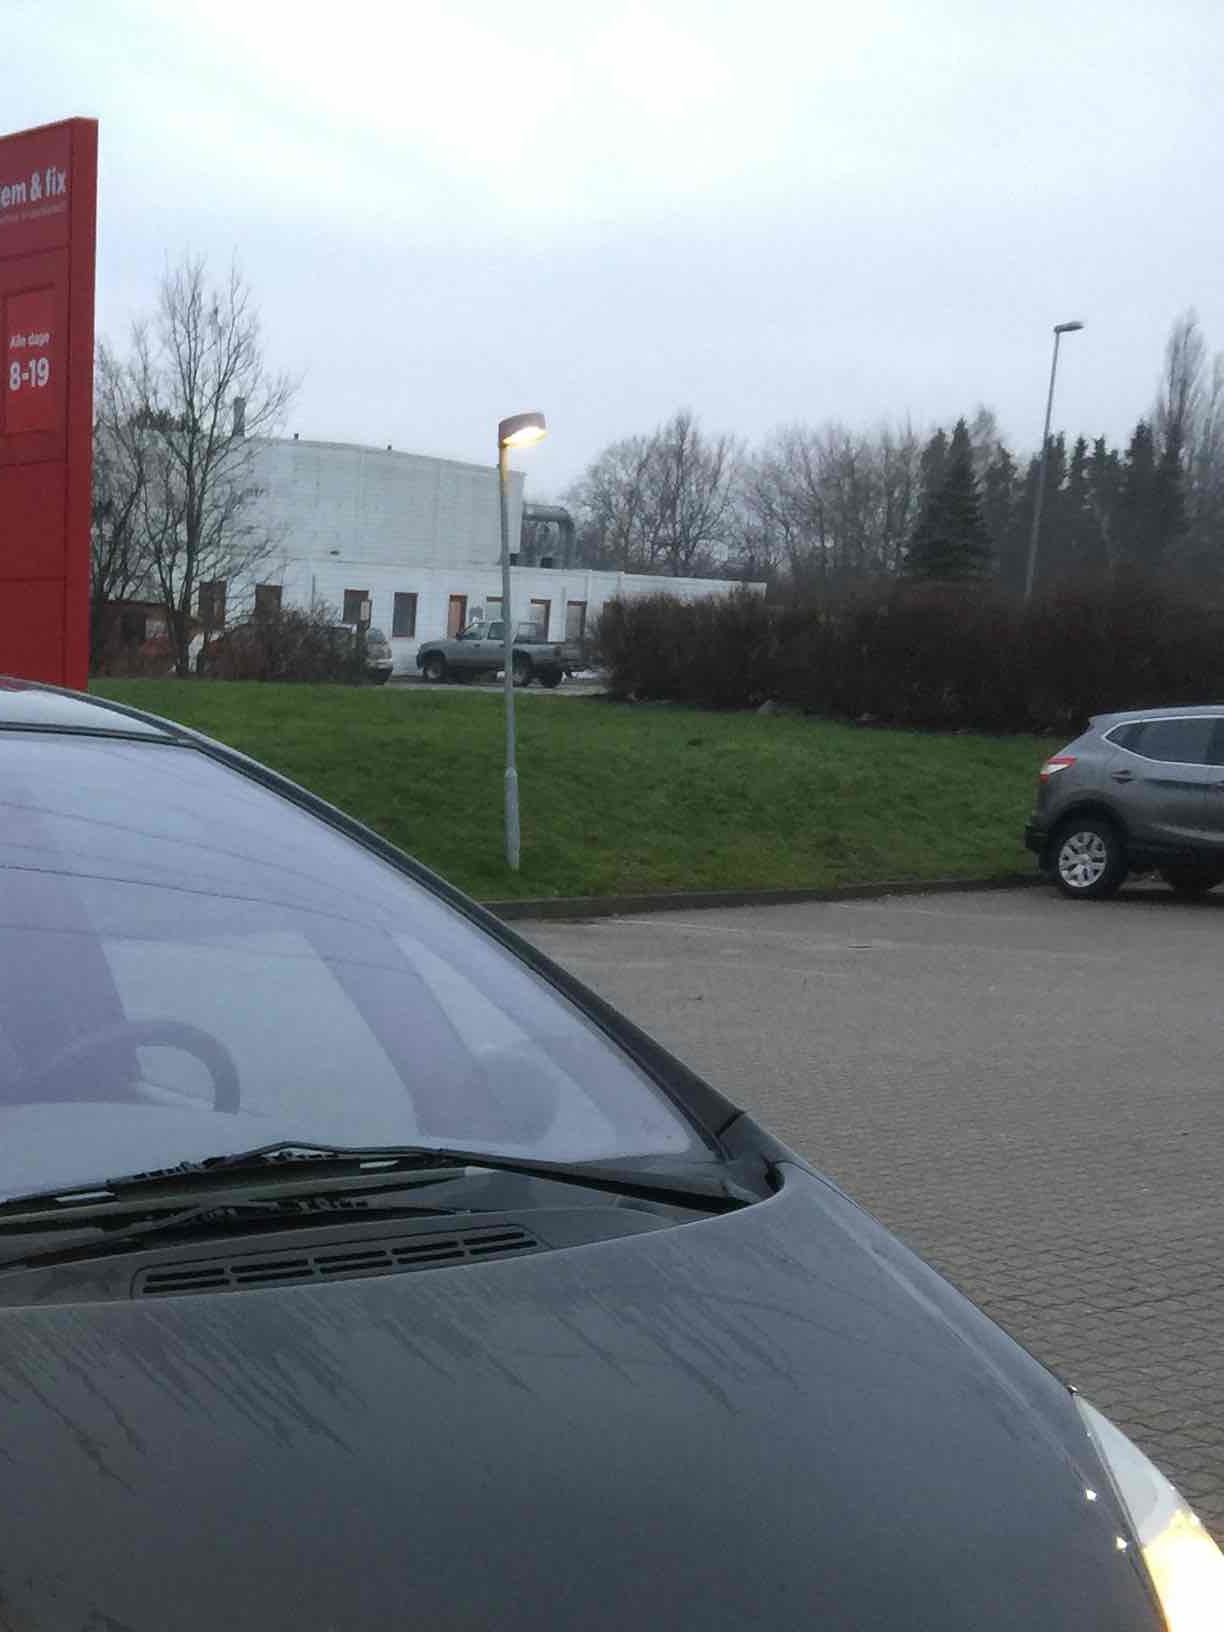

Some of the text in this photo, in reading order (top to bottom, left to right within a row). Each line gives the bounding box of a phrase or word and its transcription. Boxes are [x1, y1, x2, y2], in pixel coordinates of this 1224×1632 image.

[30, 172, 42, 201] &
[45, 166, 66, 197] fix
[9, 358, 49, 391] 8-19
